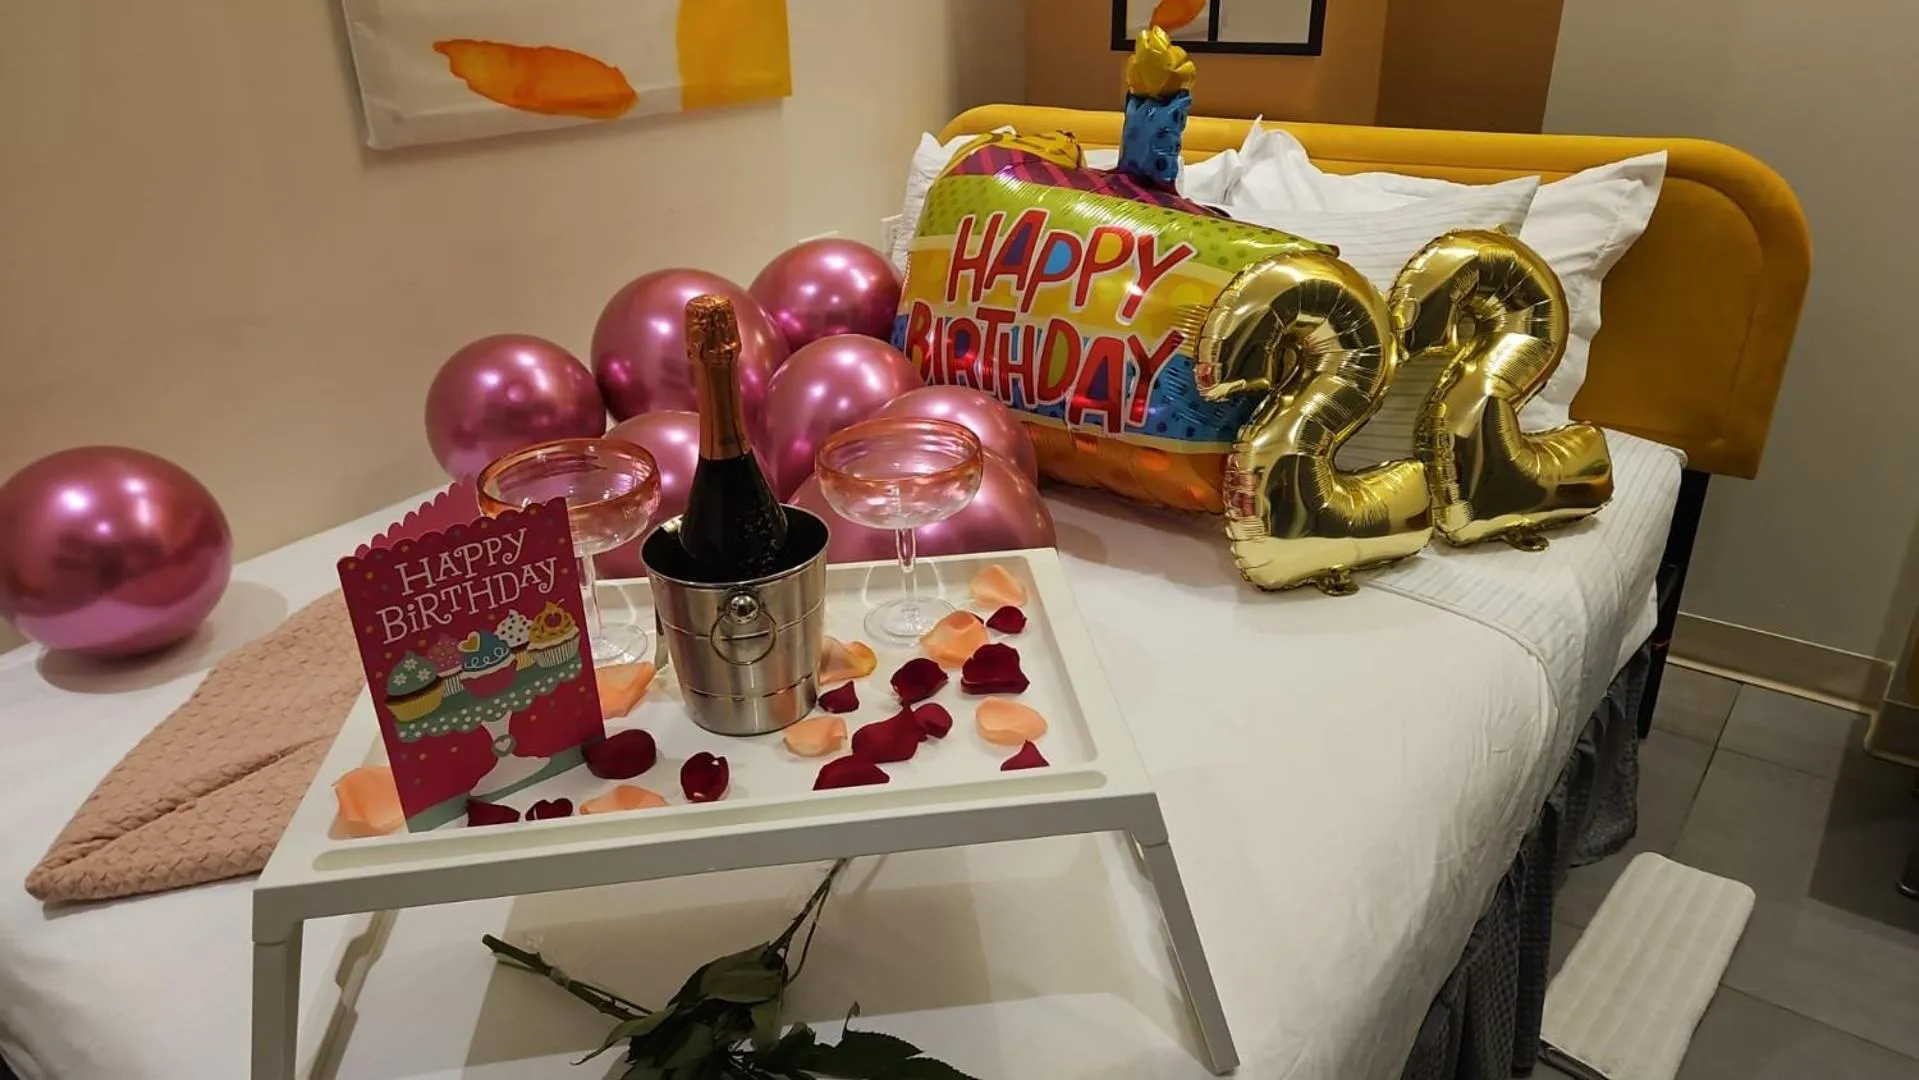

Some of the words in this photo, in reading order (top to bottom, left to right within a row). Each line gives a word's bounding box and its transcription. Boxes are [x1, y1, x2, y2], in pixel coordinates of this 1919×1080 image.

[946, 209, 1197, 325] HAPPY
[904, 300, 1187, 436] BIRTHDAY
[395, 527, 528, 597] HAPPY
